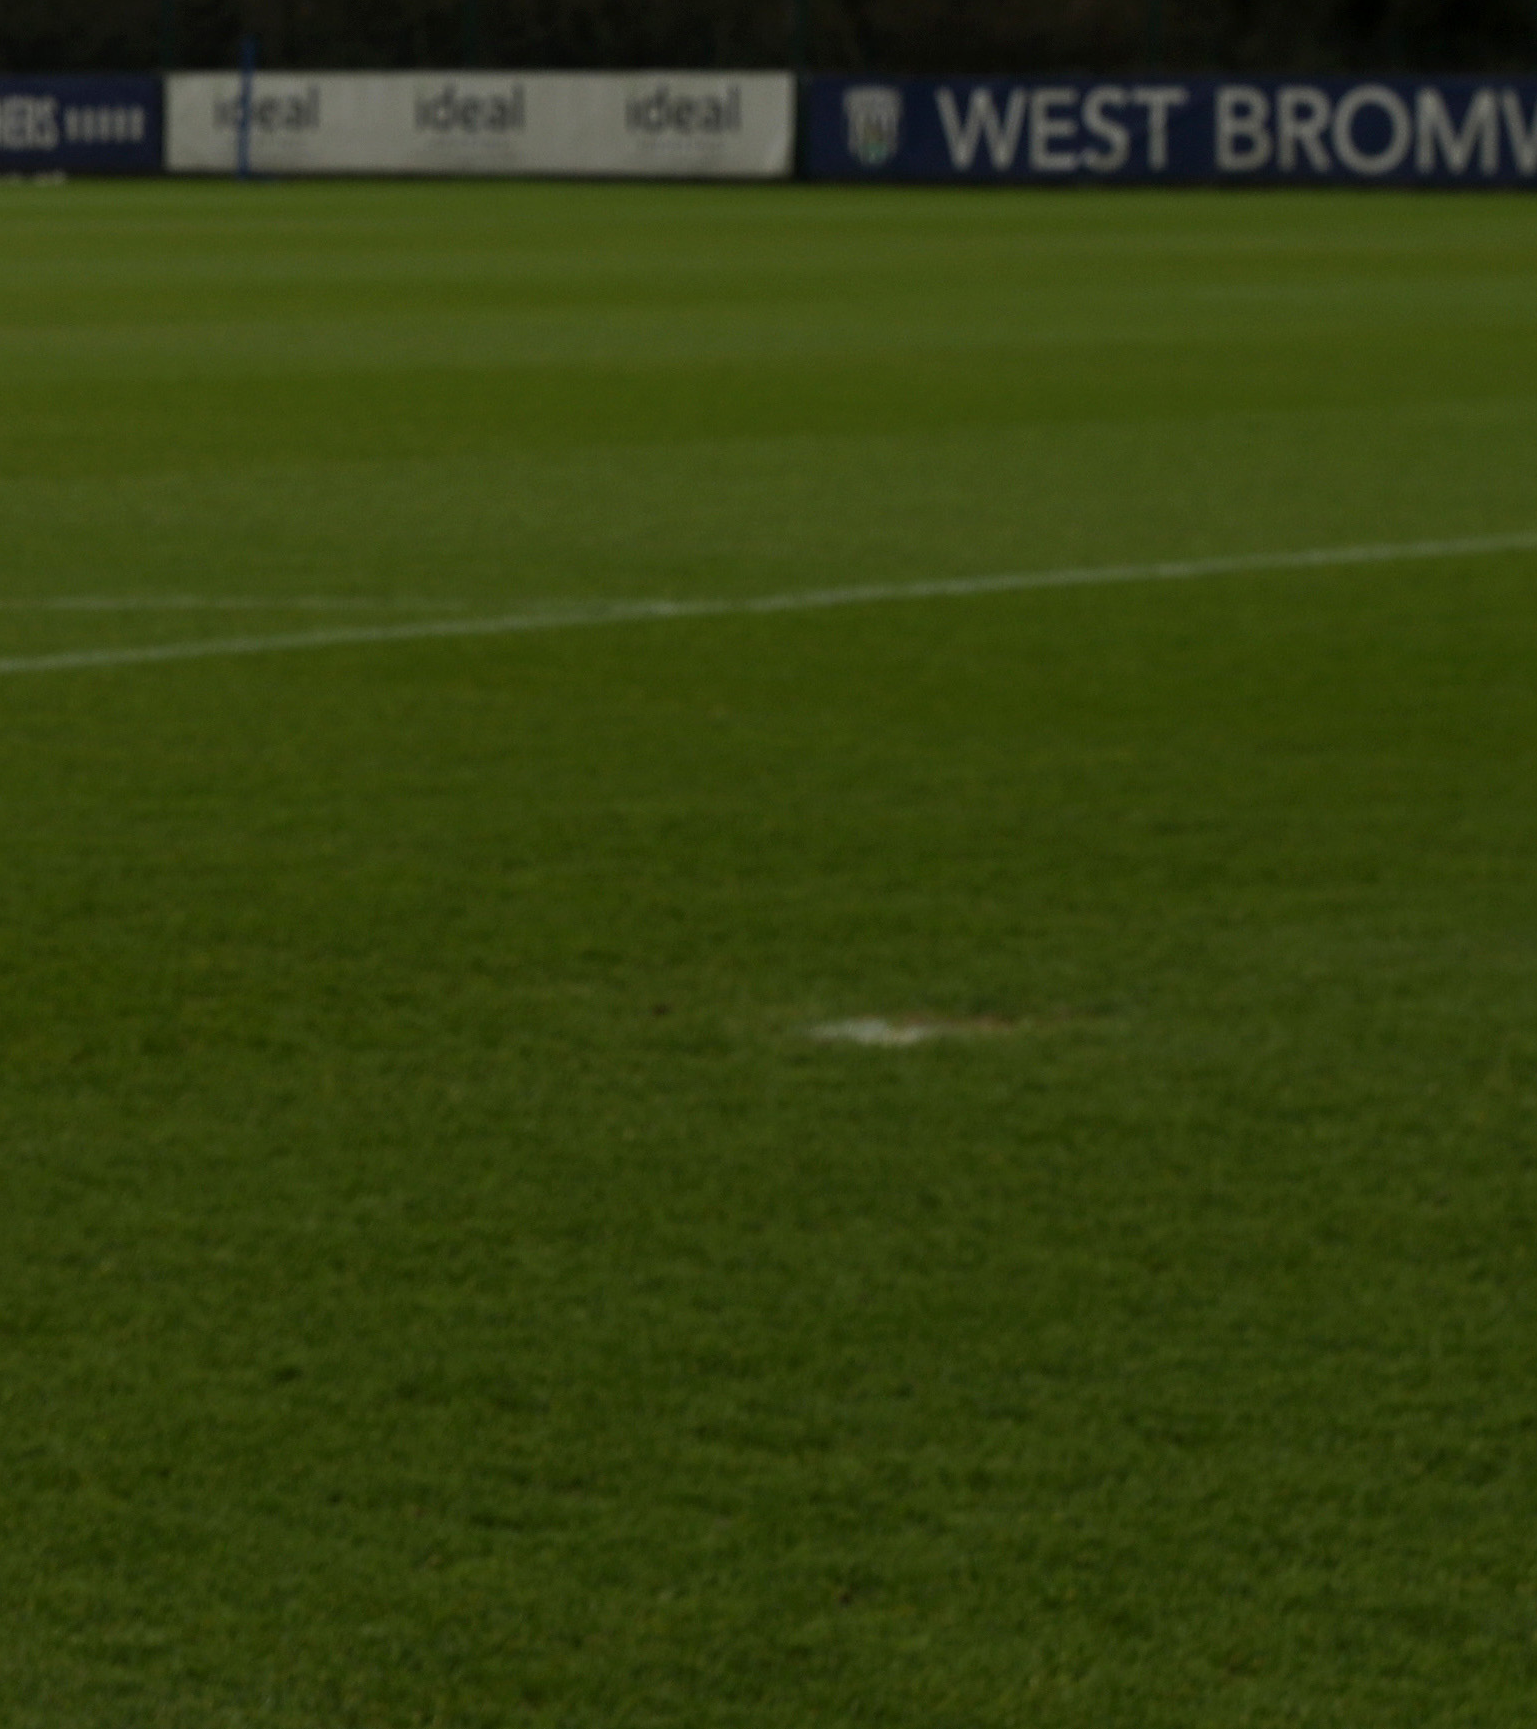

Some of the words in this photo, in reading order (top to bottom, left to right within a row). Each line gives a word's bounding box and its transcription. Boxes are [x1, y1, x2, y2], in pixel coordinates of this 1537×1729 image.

[213, 84, 322, 134] ideal
[414, 83, 526, 135] ideal
[625, 83, 741, 135] ideal
[934, 84, 1189, 173] WEST
